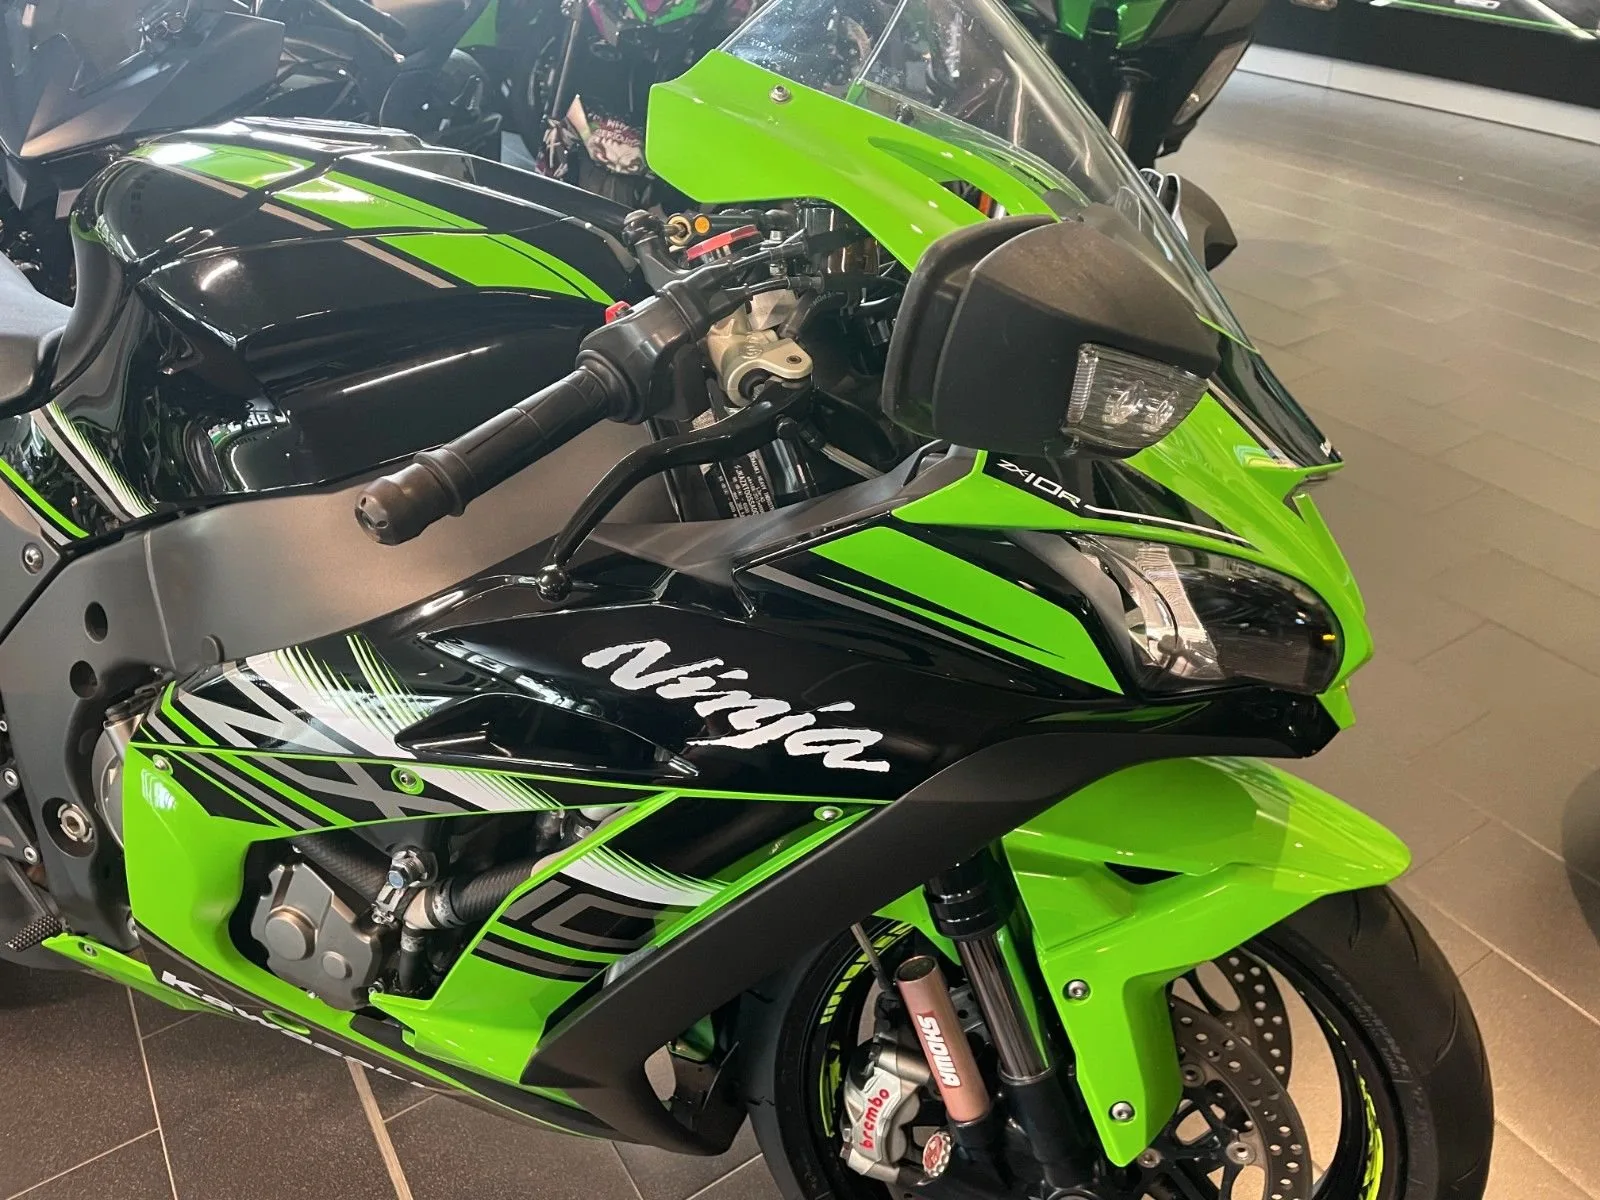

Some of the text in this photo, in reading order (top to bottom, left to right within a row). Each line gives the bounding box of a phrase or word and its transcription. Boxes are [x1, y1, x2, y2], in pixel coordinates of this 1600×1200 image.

[582, 640, 891, 772] Ninja
[916, 1012, 962, 1088] SHOWA
[859, 1088, 891, 1151] brembo
